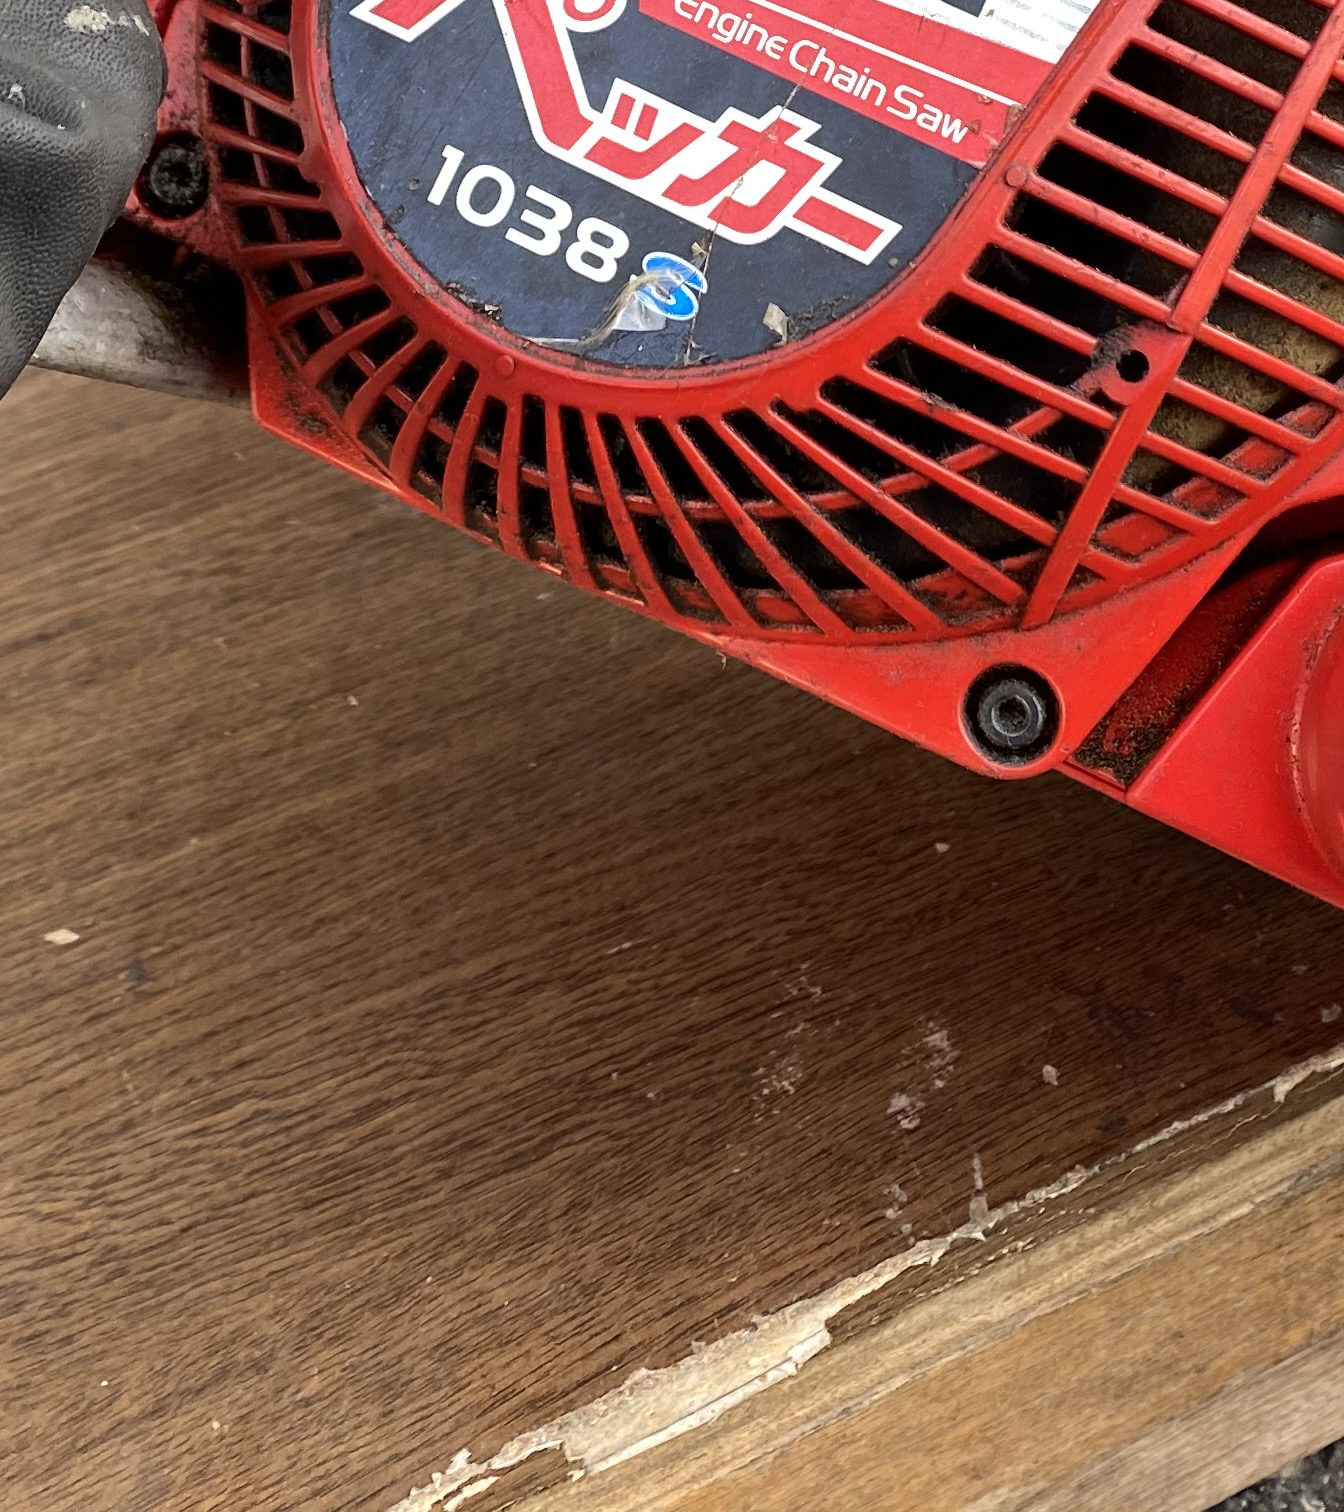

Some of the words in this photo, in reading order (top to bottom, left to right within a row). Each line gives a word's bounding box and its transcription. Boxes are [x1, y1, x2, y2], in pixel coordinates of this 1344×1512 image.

[789, 39, 887, 107] Chain
[886, 84, 970, 144] Saw
[427, 143, 631, 284] 1038
